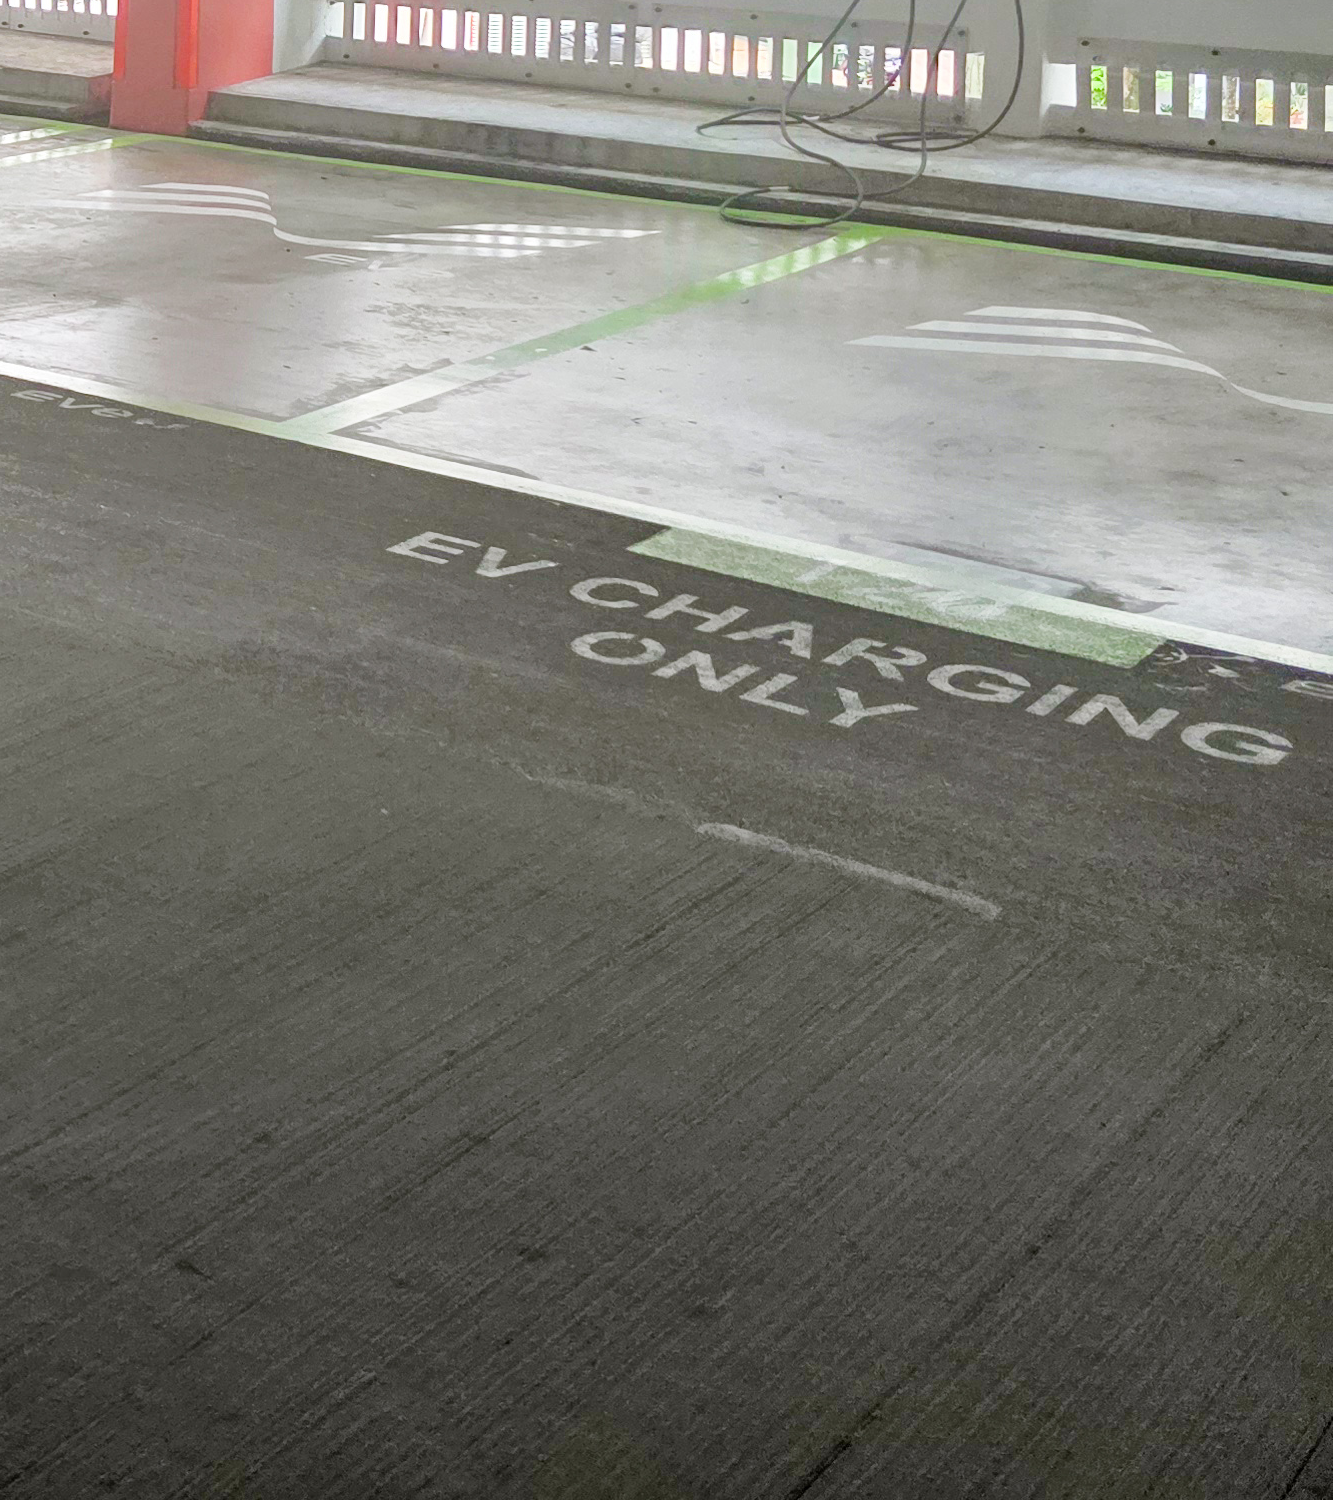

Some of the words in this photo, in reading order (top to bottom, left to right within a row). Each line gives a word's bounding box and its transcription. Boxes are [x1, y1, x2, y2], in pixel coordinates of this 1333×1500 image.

[384, 529, 560, 579] EV
[567, 575, 1296, 765] CHARGING
[570, 630, 920, 728] ONLY
